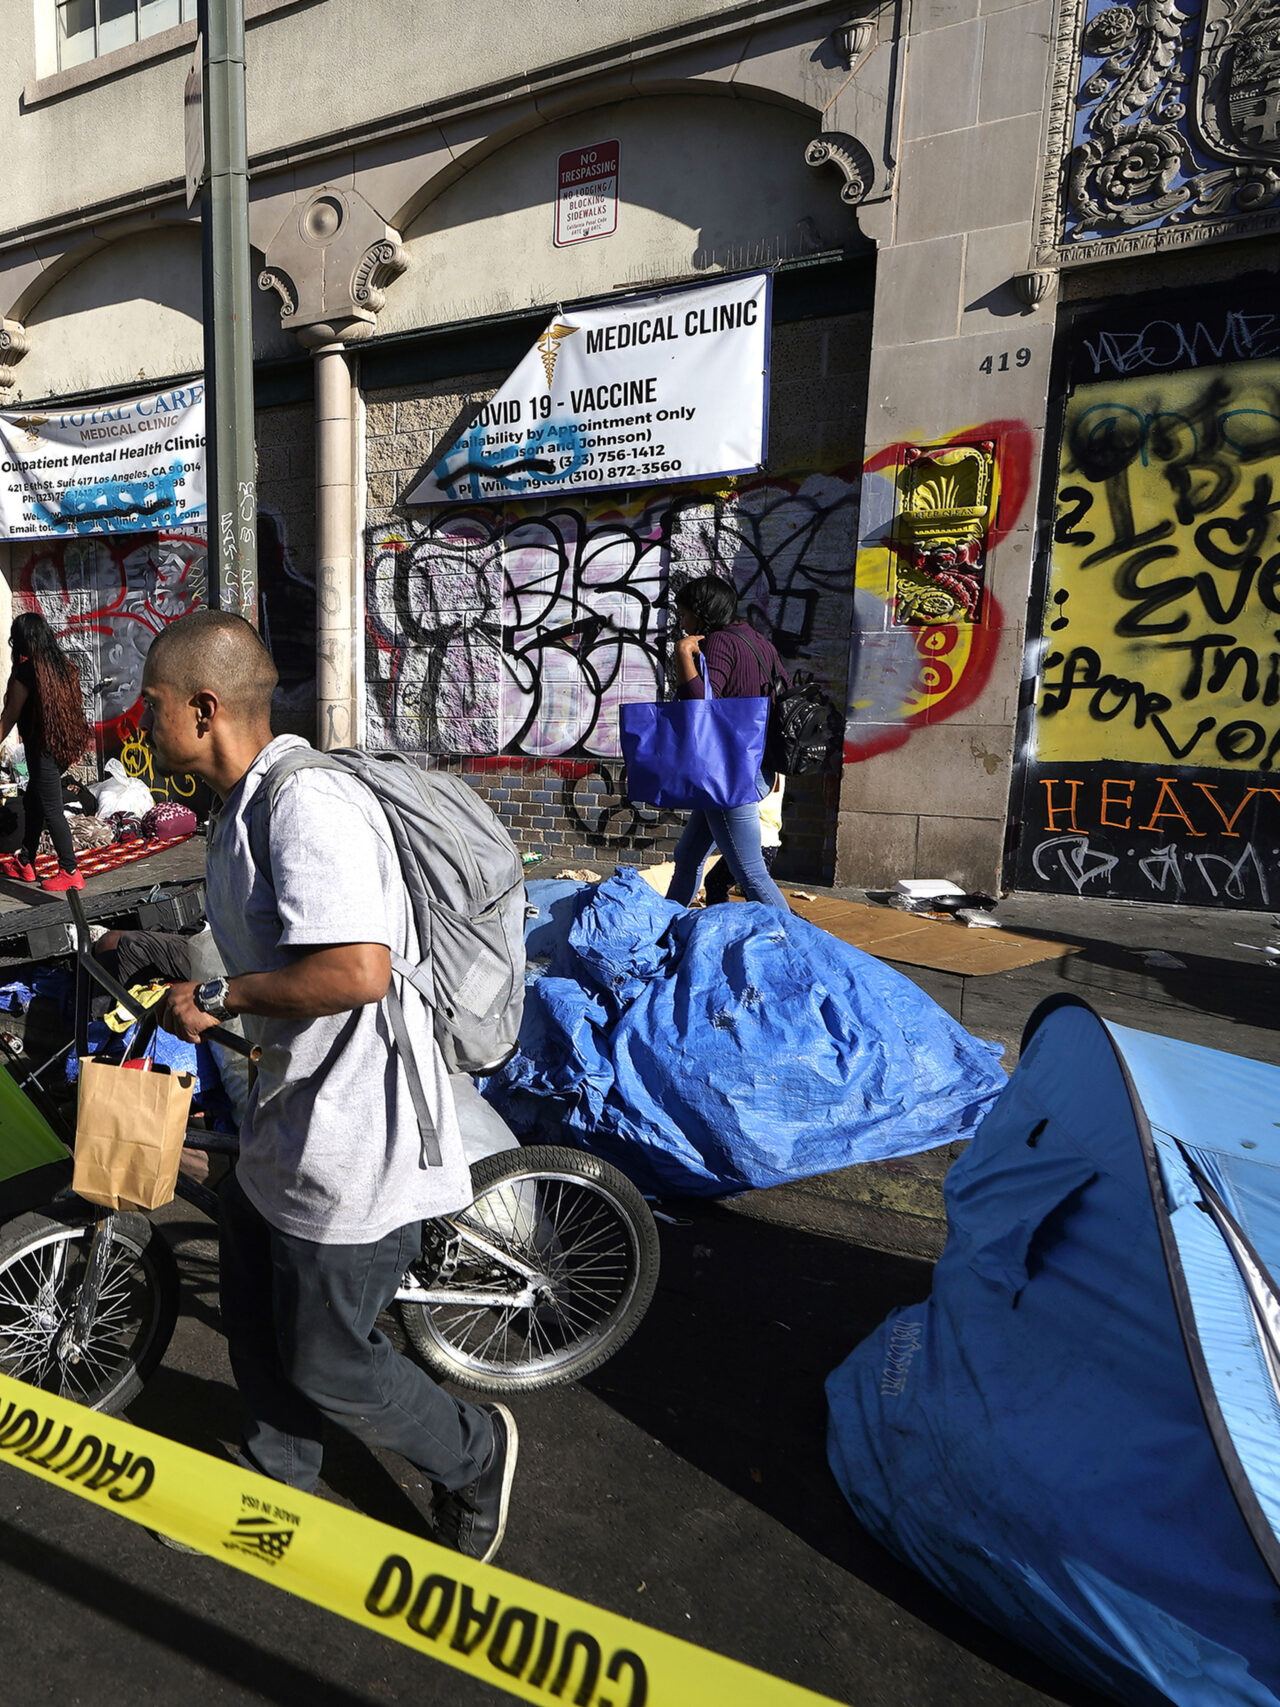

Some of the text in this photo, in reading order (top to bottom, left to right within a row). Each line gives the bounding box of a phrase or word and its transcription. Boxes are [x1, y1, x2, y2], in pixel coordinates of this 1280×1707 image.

[580, 151, 597, 166] NO
[561, 160, 616, 184] TRESPASSING
[563, 179, 613, 201] NO LODGING/
[569, 193, 605, 211] BLOCKING
[566, 204, 607, 222] SIDEWALKS
[586, 299, 758, 355] MEDICAL CLINIC
[979, 347, 1032, 375] 419
[136, 385, 204, 417] CARE
[529, 394, 552, 420] 19
[570, 377, 658, 414] VACCINE
[80, 415, 179, 441] MEDICAL CLINIC
[526, 428, 544, 442] by
[546, 412, 652, 438] Appointment
[656, 406, 697, 421] Only
[547, 439, 575, 453] and
[578, 428, 652, 449] Johnson)
[597, 444, 665, 463] 756-1412
[1, 455, 69, 474] Outpatient
[71, 449, 117, 467] Mental
[119, 441, 162, 461] Health
[7, 484, 22, 493] 421
[43, 481, 55, 490] St.
[56, 478, 76, 488] Suit
[77, 476, 93, 486] 417
[94, 474, 110, 485] Los
[111, 469, 150, 482] Angeles,
[151, 466, 167, 477] CA
[168, 462, 202, 474] 90014
[568, 467, 604, 485] (310)
[607, 459, 682, 479] 872-3560
[9, 523, 37, 534] Email:
[241, 1494, 301, 1526] MADE IN USA
[363, 1553, 649, 1707] CUIDADO
